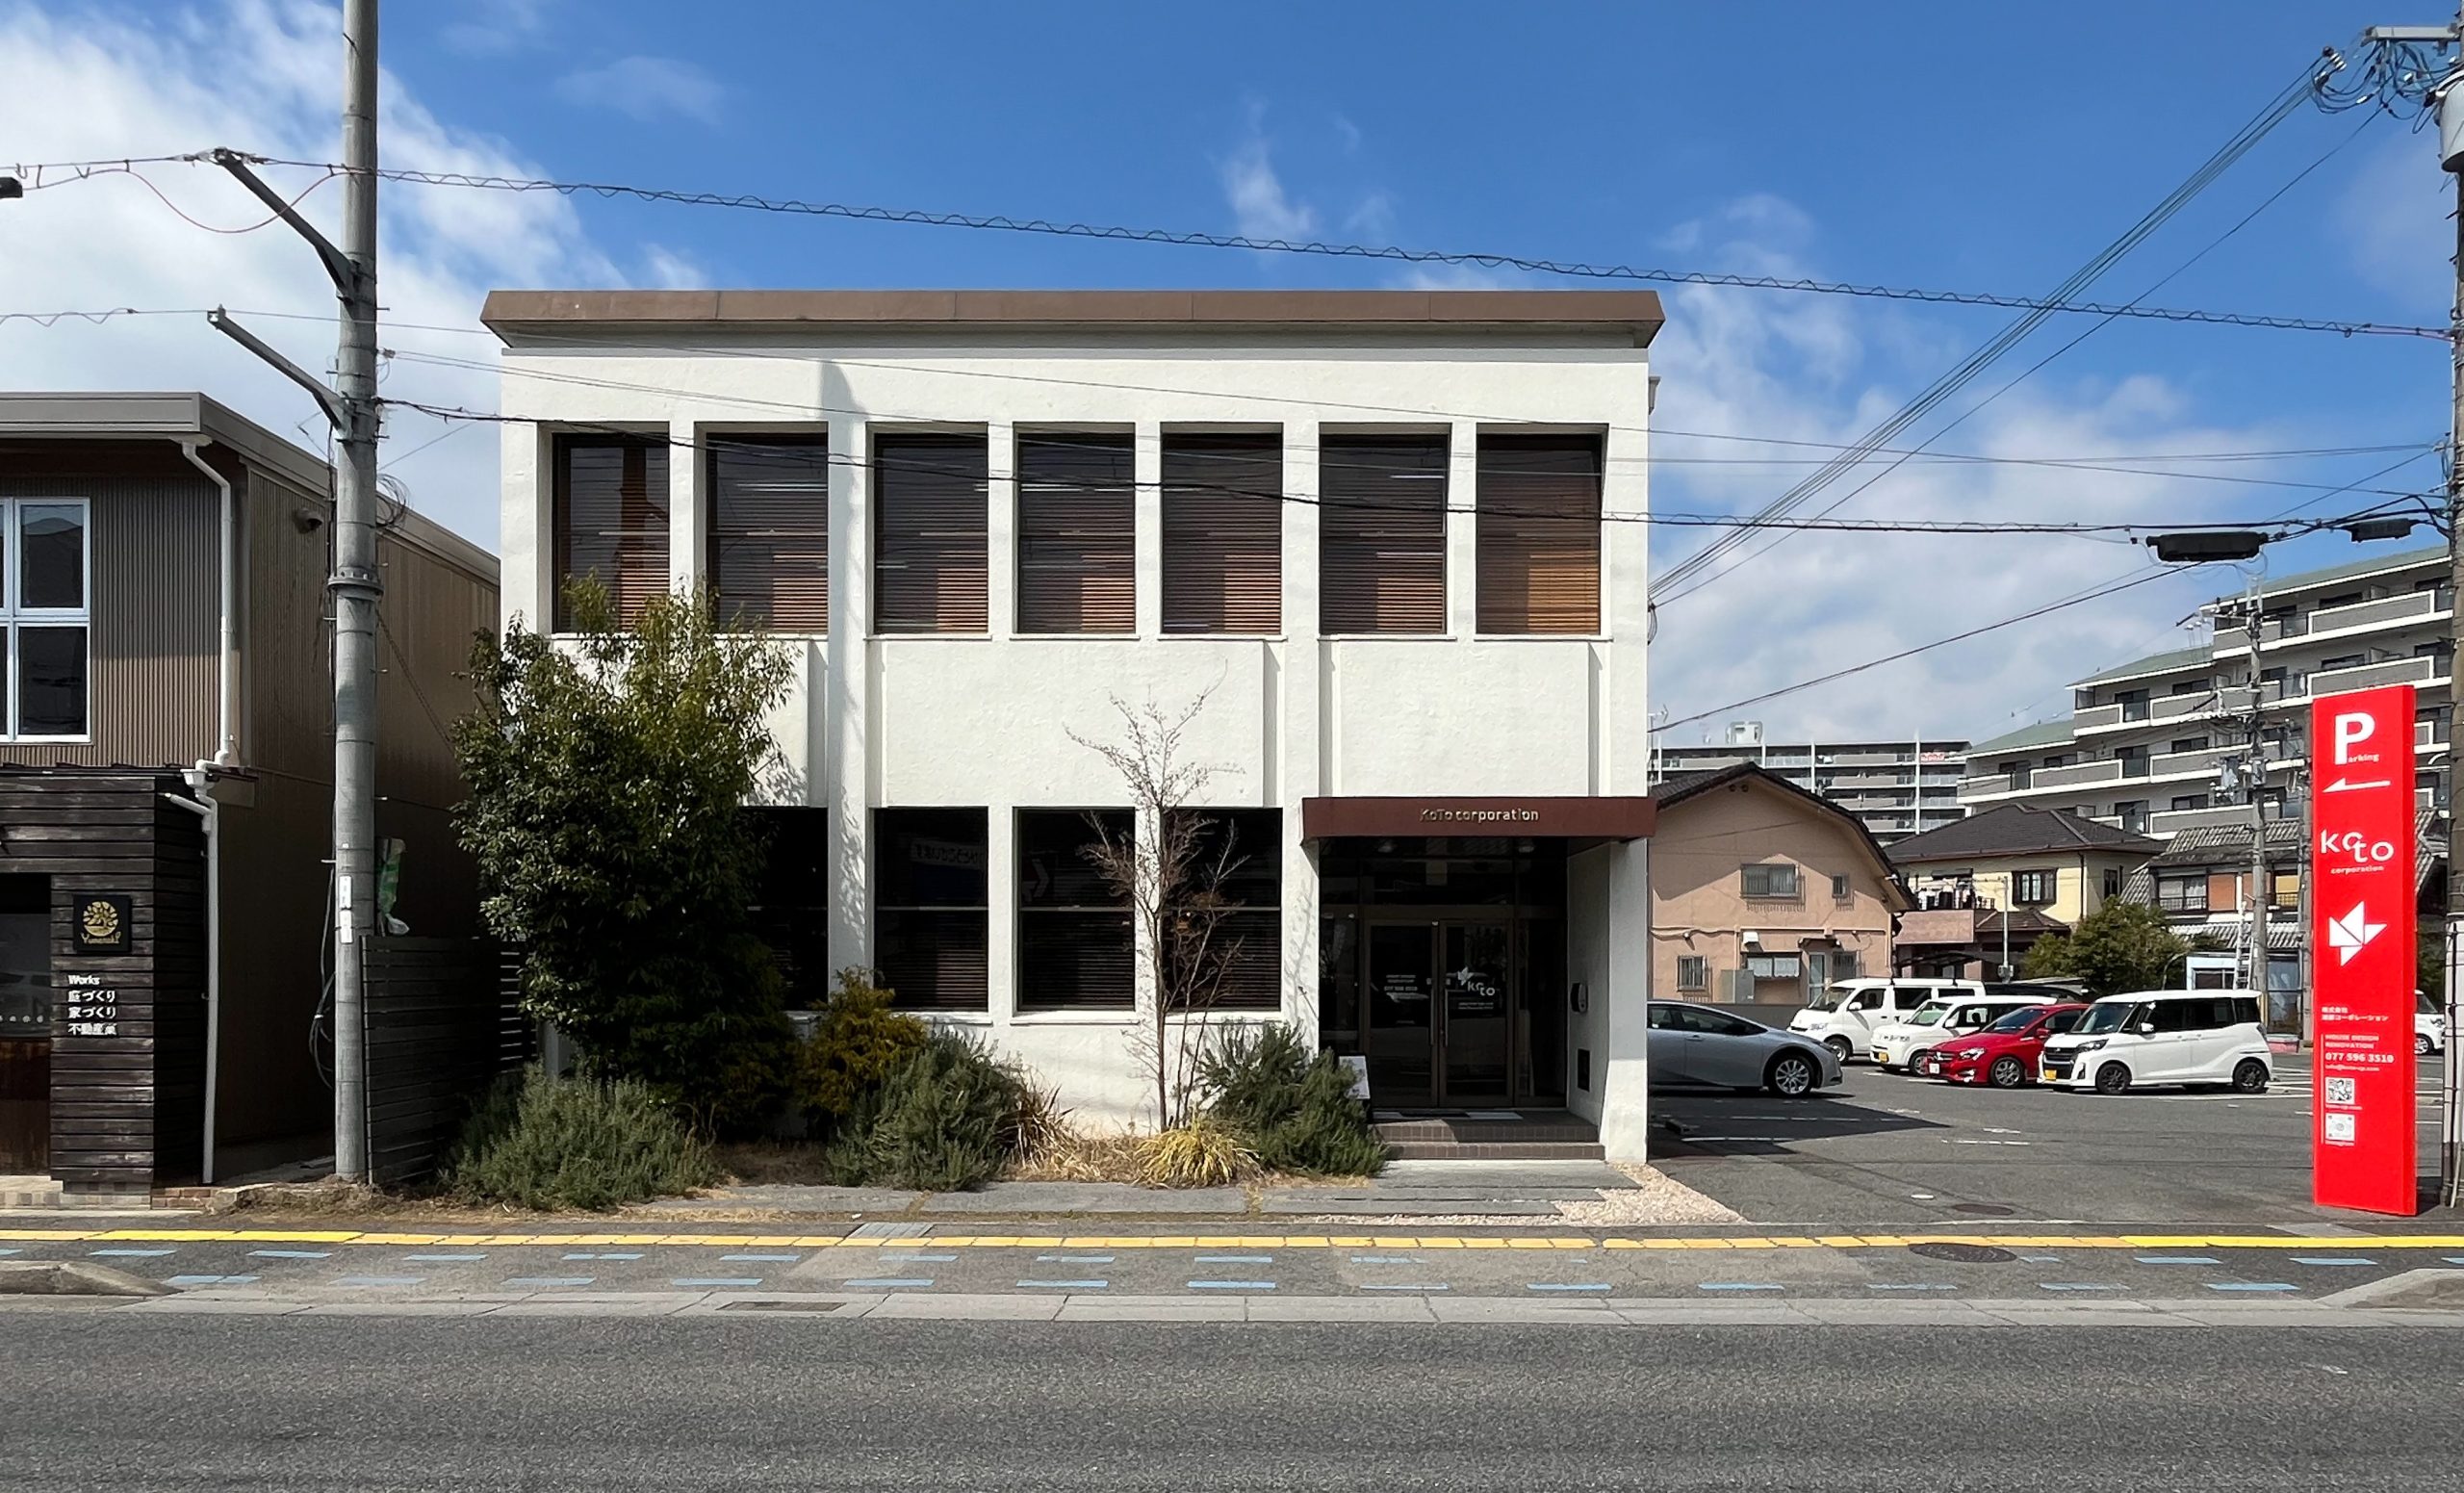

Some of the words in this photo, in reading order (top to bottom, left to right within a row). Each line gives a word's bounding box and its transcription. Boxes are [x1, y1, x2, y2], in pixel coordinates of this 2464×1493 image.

[1456, 809, 1539, 824] corporation
[2331, 864, 2384, 875] corporation
[68, 974, 101, 986] Works
[68, 990, 116, 1003] 庭づくり
[68, 1006, 116, 1019] 家づくり
[2324, 1052, 2345, 1061] 077
[2346, 1052, 2366, 1063] 596
[2368, 1053, 2395, 1064] 3510
